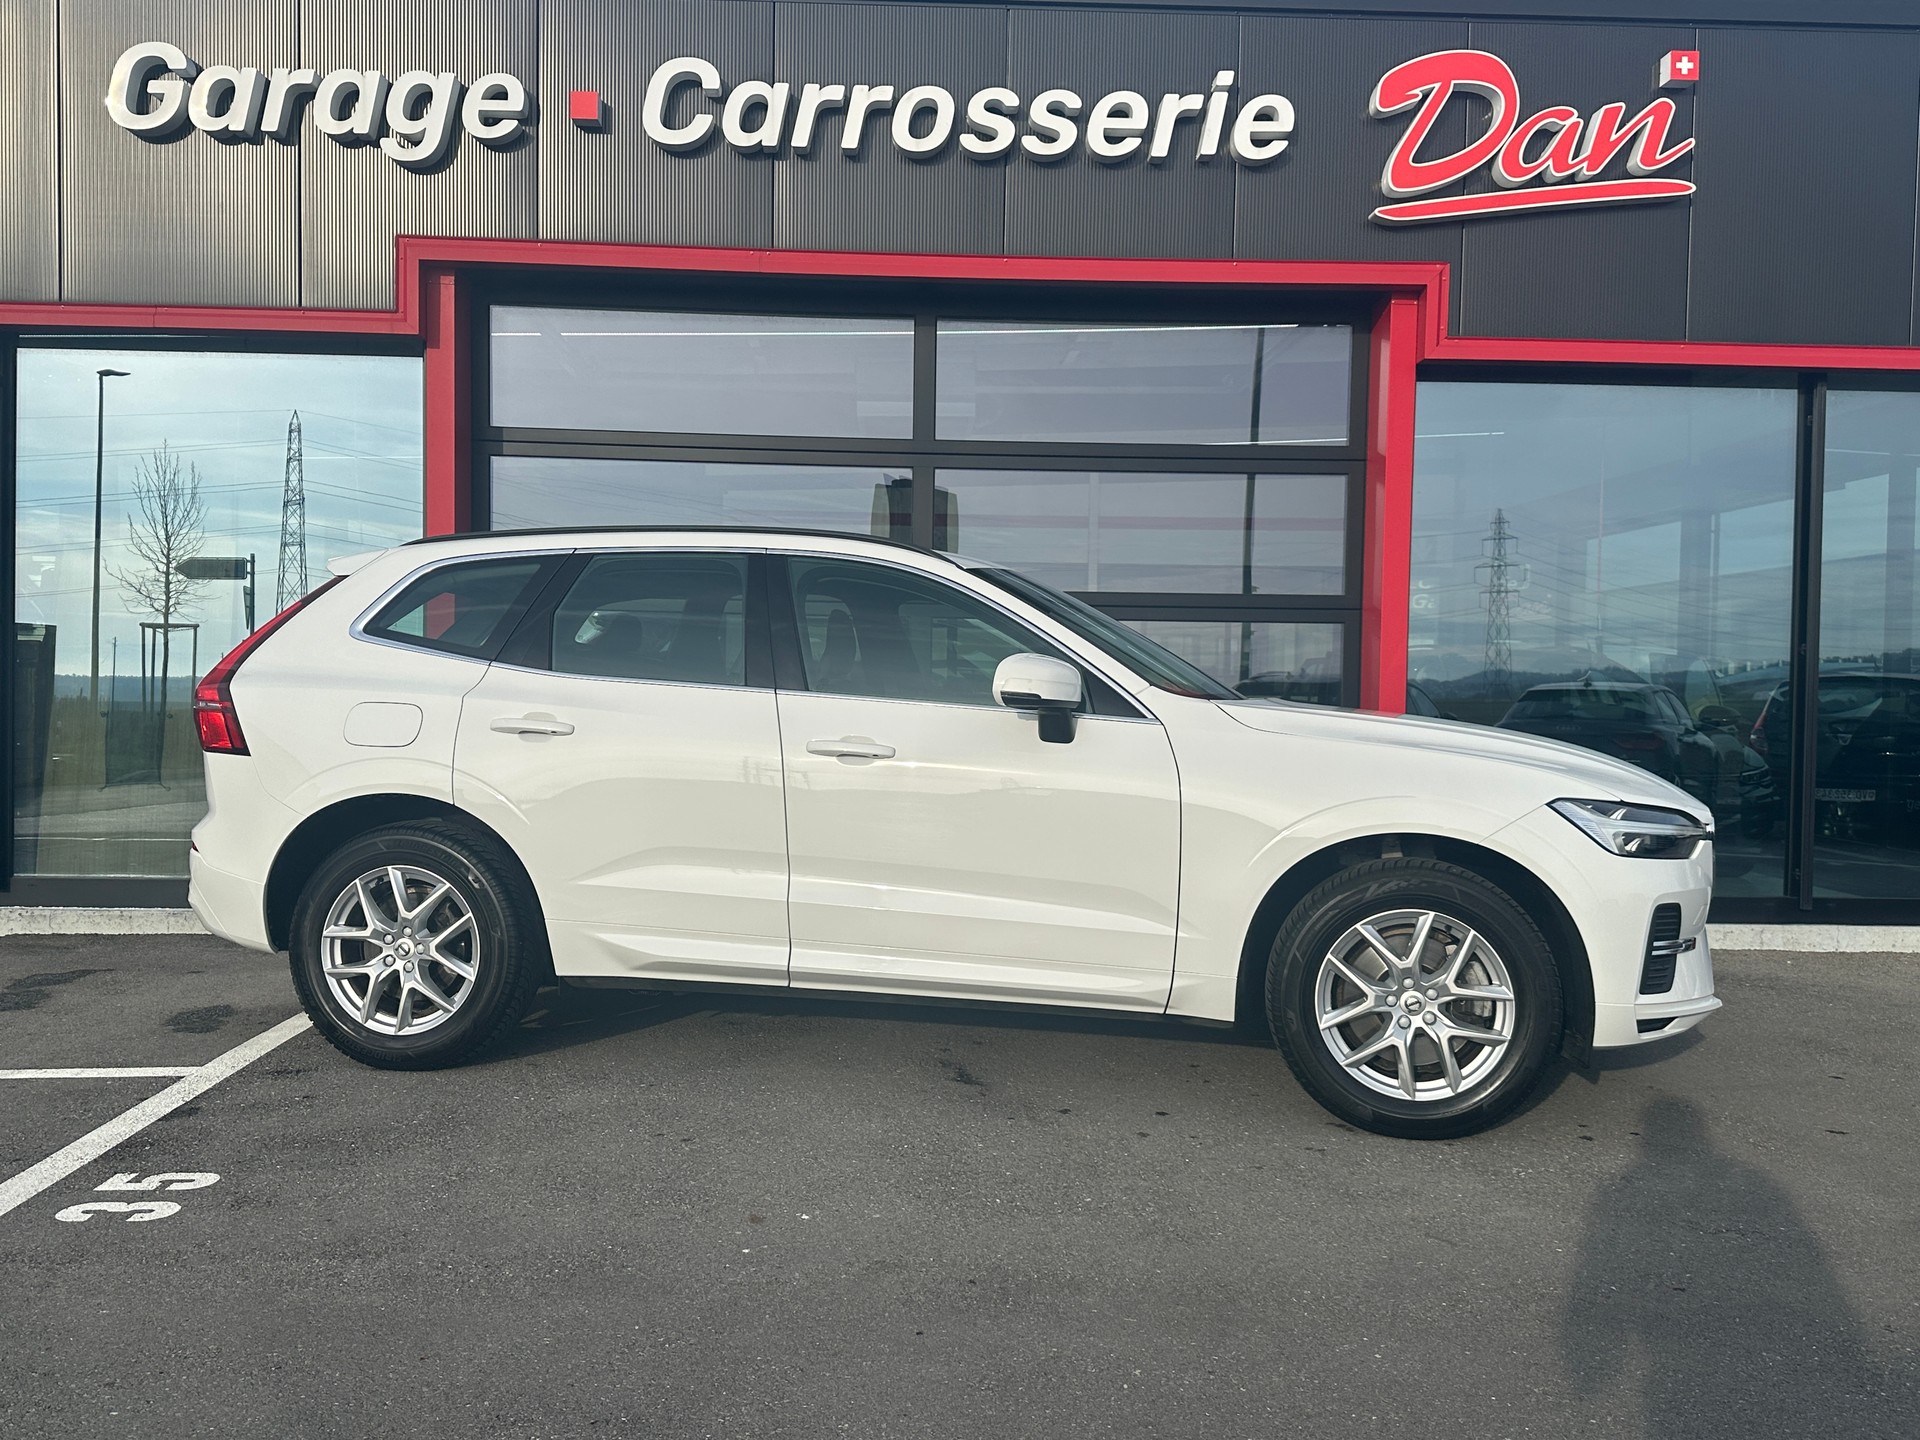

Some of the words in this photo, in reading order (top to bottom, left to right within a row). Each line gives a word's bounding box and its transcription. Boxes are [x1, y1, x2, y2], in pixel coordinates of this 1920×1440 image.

[106, 41, 530, 166] Garage
[642, 57, 1297, 166] Carrosserie
[54, 1172, 221, 1222] 35
